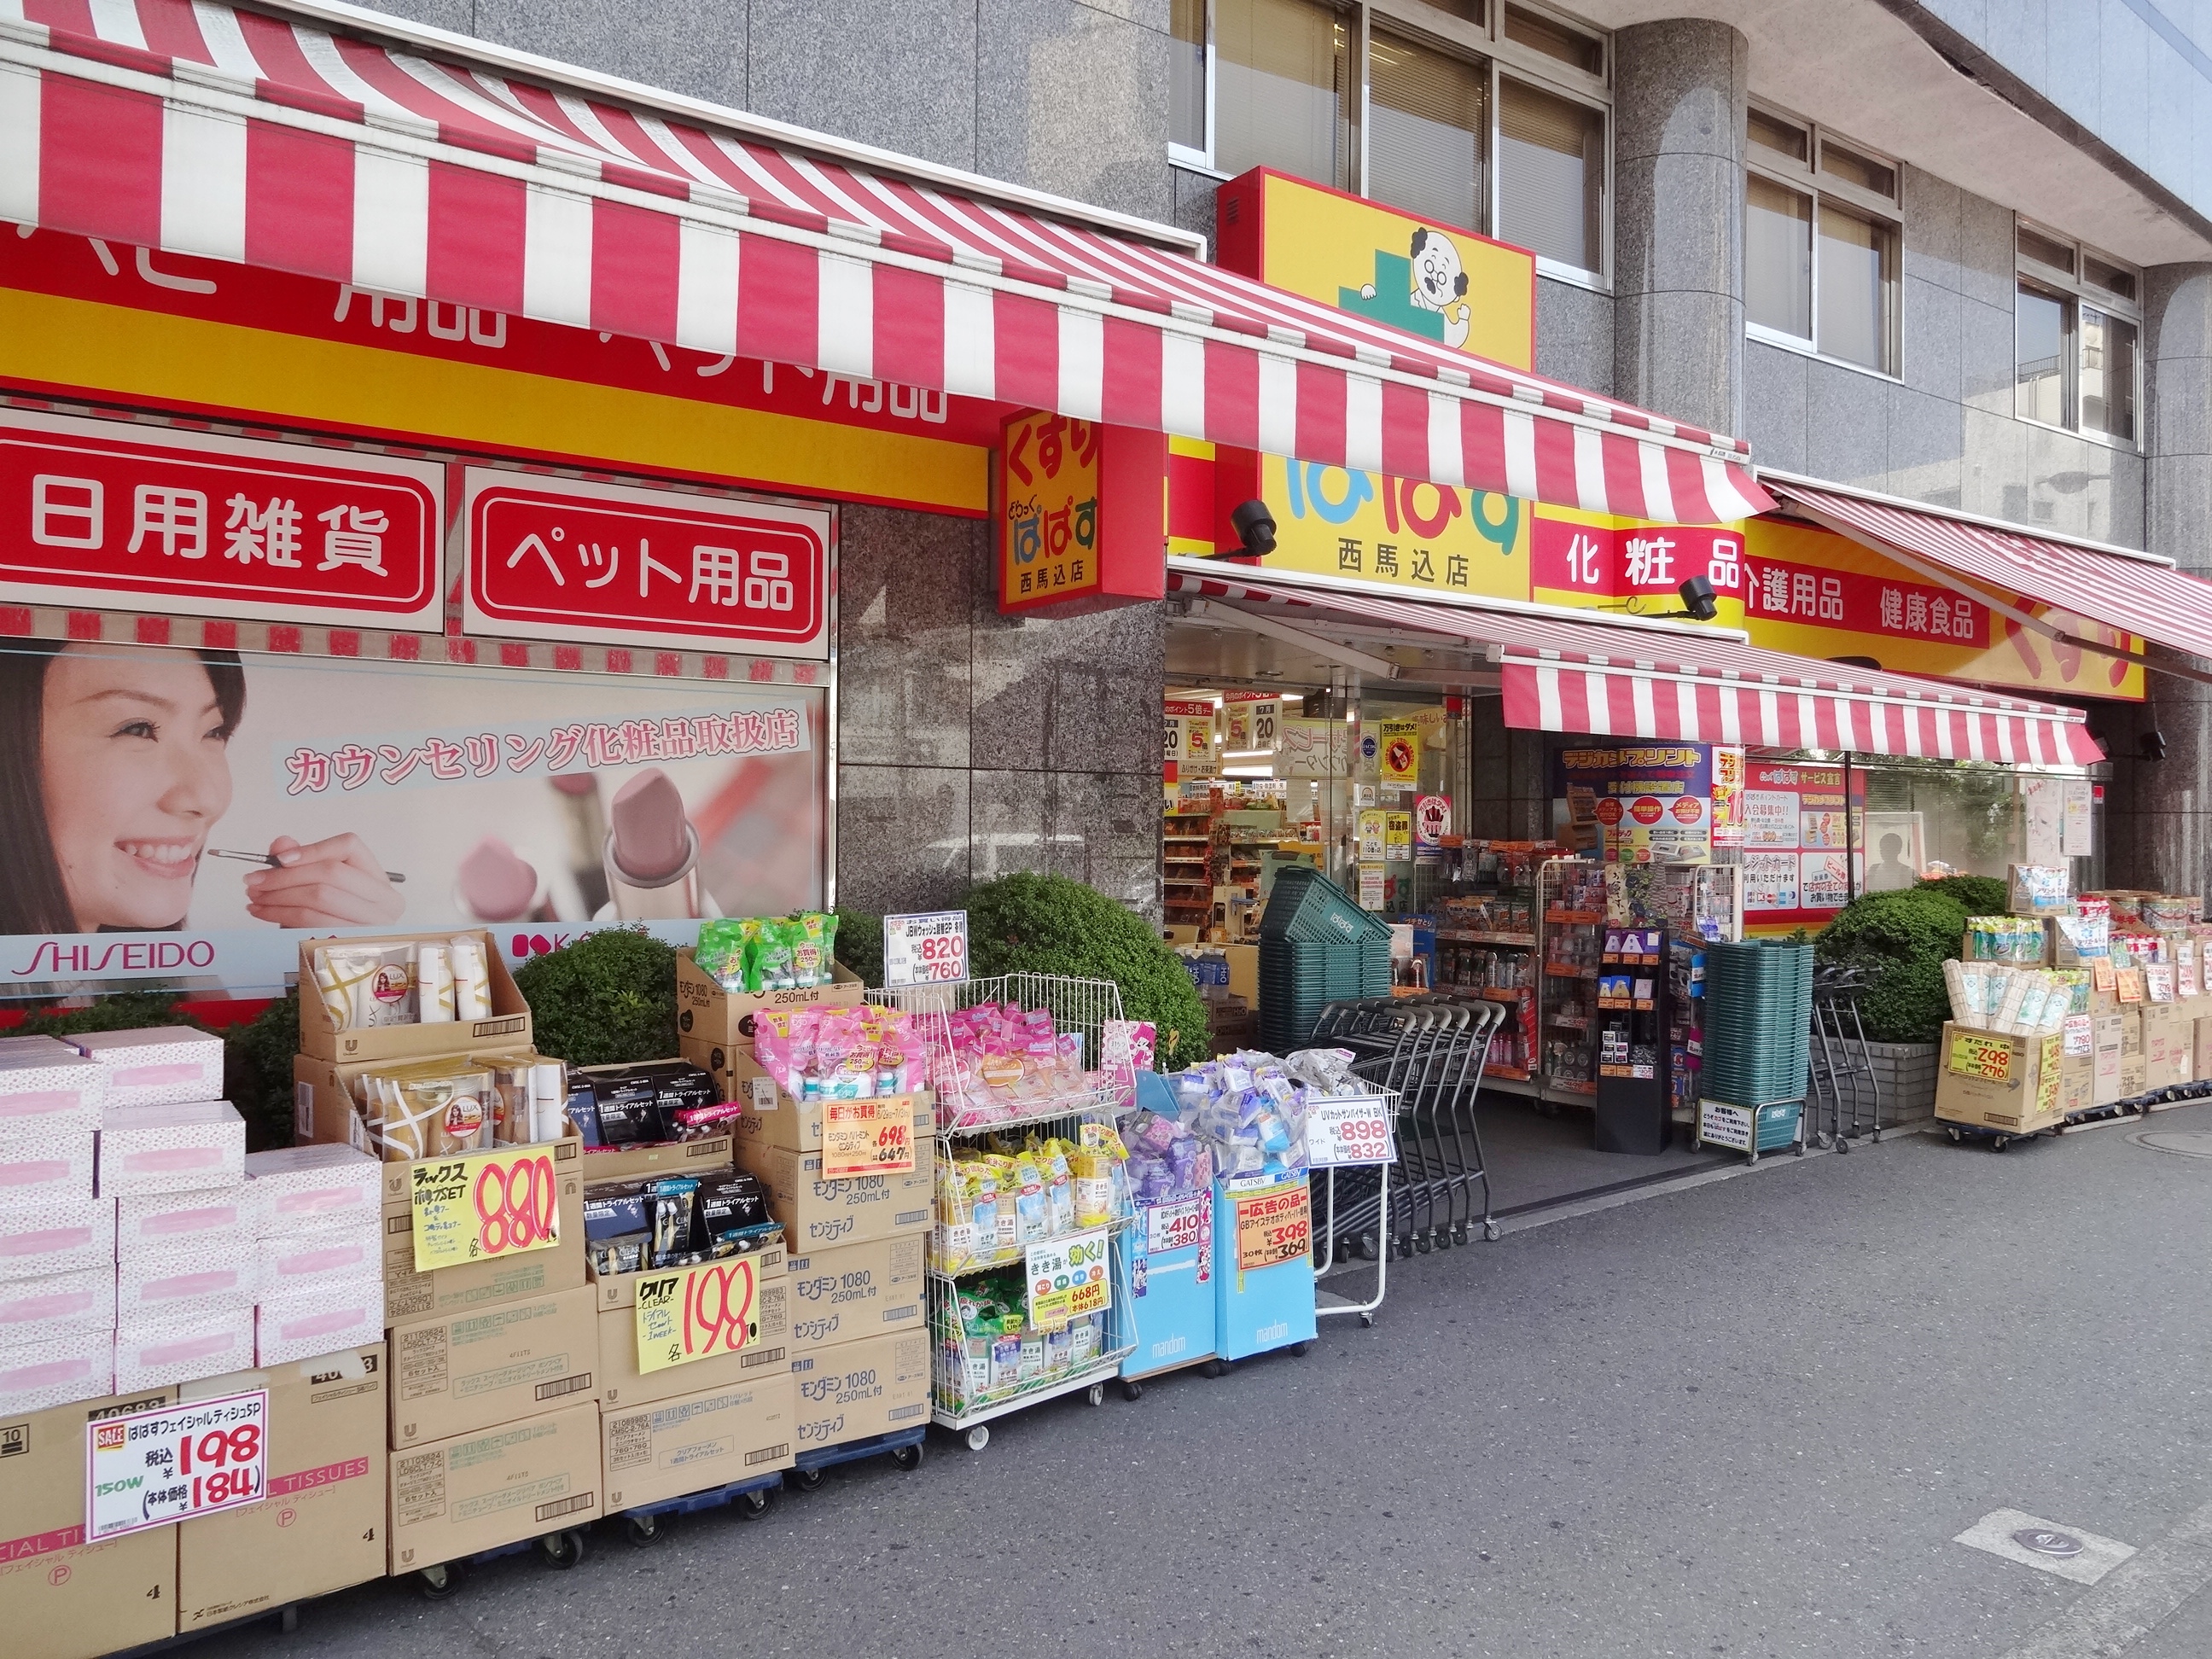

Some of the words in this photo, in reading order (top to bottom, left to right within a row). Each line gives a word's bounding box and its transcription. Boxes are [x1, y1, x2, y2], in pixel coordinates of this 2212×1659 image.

[1009, 413, 1097, 487] くすり
[32, 474, 389, 577] 日用雑貨
[1014, 495, 1097, 566] ぱぱす
[506, 527, 794, 612] ペット用品
[1338, 538, 1469, 587] 西馬込店
[1566, 533, 1740, 589] 化粧品
[1021, 560, 1084, 594] 西馬込店
[1880, 587, 1976, 640] 健康食品
[1256, 717, 1274, 738] 20
[1382, 723, 1417, 731] 万引きはダメ!
[285, 709, 800, 797] カウンセリング化粧品取扱店
[1563, 748, 1702, 768] デジカメプリント
[1801, 771, 1842, 785] サービス宣言
[12, 940, 216, 975] SHISEIDO
[922, 935, 963, 960] 820
[695, 981, 707, 998] 1080
[774, 990, 819, 1004] 250mL付
[1965, 1037, 1994, 1048] すだれ
[1978, 1047, 2009, 1066] 298
[598, 1100, 654, 1114] 1週間トライアルセット
[830, 1104, 876, 1121] 毎日がお買得
[1341, 1120, 1387, 1141] 898
[413, 1162, 469, 1187] ラックス
[1240, 1178, 1266, 1187] GATSBY
[813, 1177, 853, 1201] モンダミン
[856, 1175, 884, 1190] 1080
[846, 1189, 890, 1205] 250mL付
[473, 1155, 556, 1254] 880
[583, 1196, 644, 1211] 1週間トライアルセット
[705, 1196, 760, 1209] 1週間トライアルセット
[809, 1215, 854, 1241] センシティブ
[1169, 1214, 1199, 1232] 410
[1272, 1220, 1307, 1245] 398
[1068, 1239, 1105, 1268] 効く!
[797, 1276, 837, 1301] モンダミン
[841, 1270, 870, 1289] 1080
[831, 1285, 877, 1304] 250mL付
[1072, 1284, 1100, 1302] 668円
[684, 1260, 754, 1355] 198
[403, 1327, 444, 1341] 21103624
[794, 1313, 840, 1341] センシティブ
[1256, 1319, 1288, 1344] mandom
[1152, 1333, 1186, 1359] mandom
[800, 1375, 841, 1401] モンダミン
[845, 1369, 876, 1388] 1080
[835, 1384, 883, 1405] 250mL付
[612, 1415, 649, 1429] 21089983
[798, 1413, 845, 1441] センシティブ
[3, 1429, 20, 1442] 10
[98, 1425, 125, 1446] SALE
[145, 1447, 173, 1467] 税込
[180, 1424, 261, 1476] 198
[399, 1452, 441, 1468] 21103624
[284, 1459, 367, 1490] TISSUES
[95, 1476, 144, 1497] 150W
[363, 1528, 375, 1542] 4
[147, 1585, 160, 1599] 4
